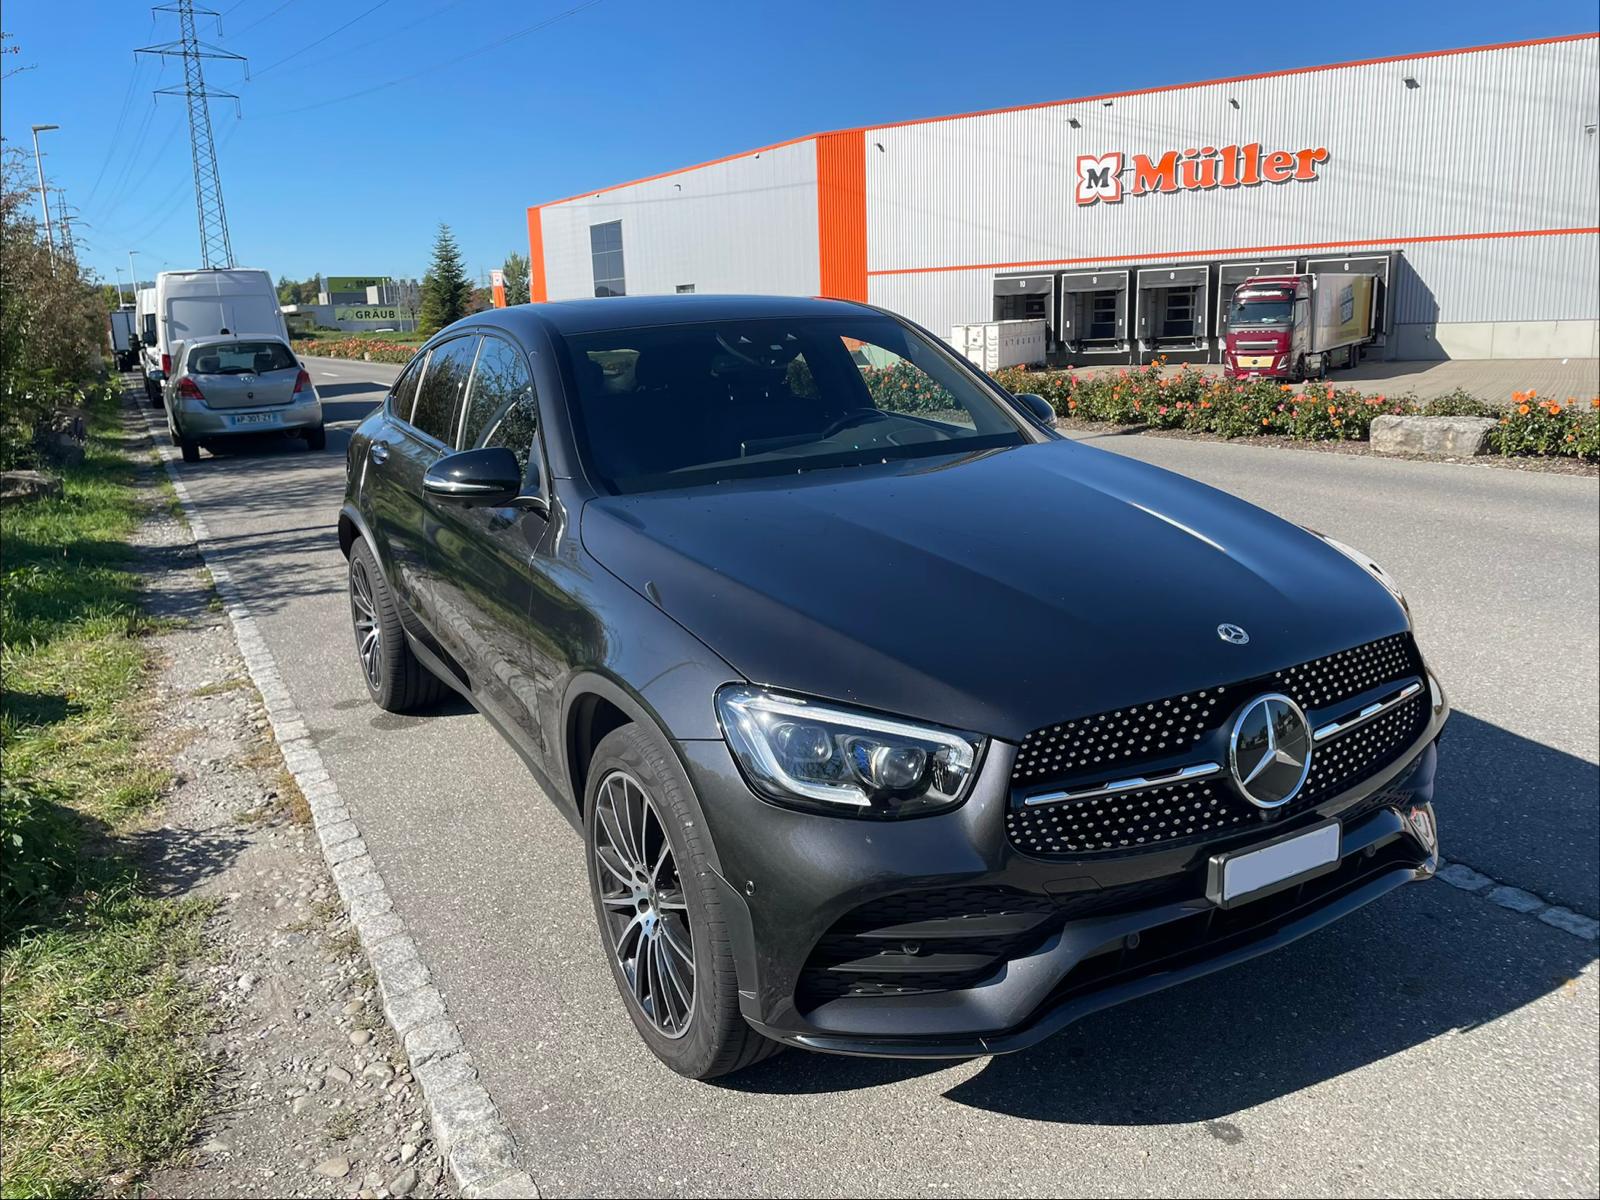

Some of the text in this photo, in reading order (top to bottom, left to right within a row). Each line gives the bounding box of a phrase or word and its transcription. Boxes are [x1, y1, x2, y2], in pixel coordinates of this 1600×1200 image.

[1086, 142, 1329, 195] M Müller
[355, 308, 395, 319] GRÄUB
